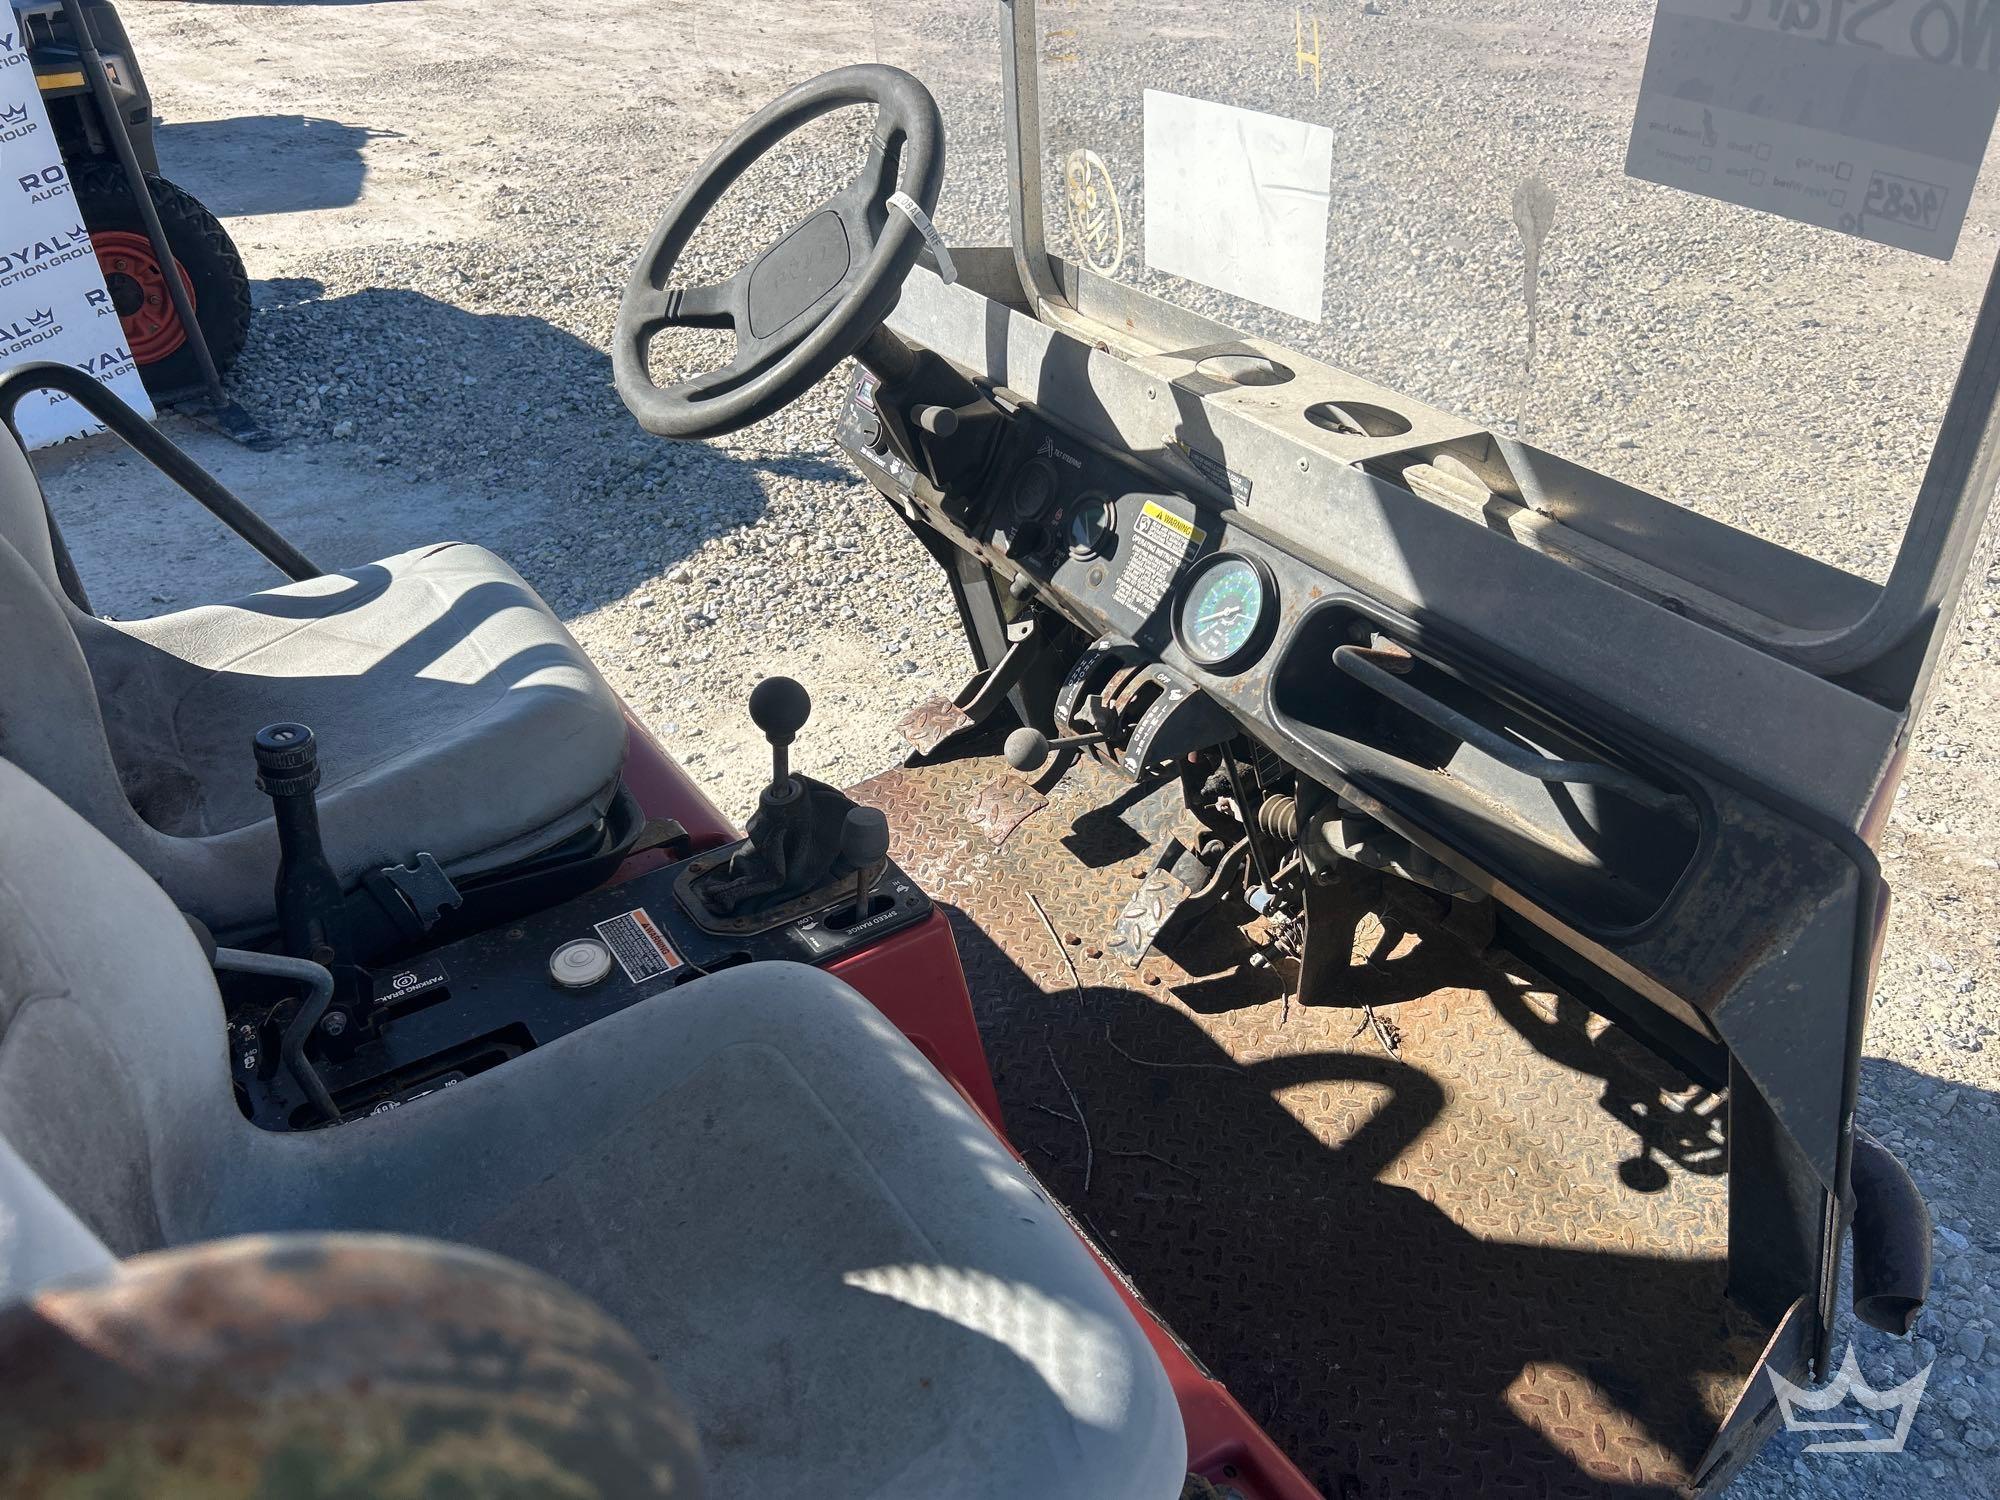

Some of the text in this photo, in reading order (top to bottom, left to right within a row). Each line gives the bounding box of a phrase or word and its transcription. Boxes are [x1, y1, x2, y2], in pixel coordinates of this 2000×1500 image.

[923, 222, 941, 247] TURF
[0, 262, 48, 289] CTION
[11, 325, 64, 354] GROUP
[1164, 514, 1192, 537] WARNING
[1132, 533, 1157, 553] OPERATING
[1156, 672, 1172, 685] OFF
[797, 916, 814, 926] LOW
[845, 910, 898, 936] SPEED RANGE
[644, 926, 670, 955] WARNING
[374, 975, 444, 1002] PARKING BRAK
[443, 1079, 458, 1088] ON
